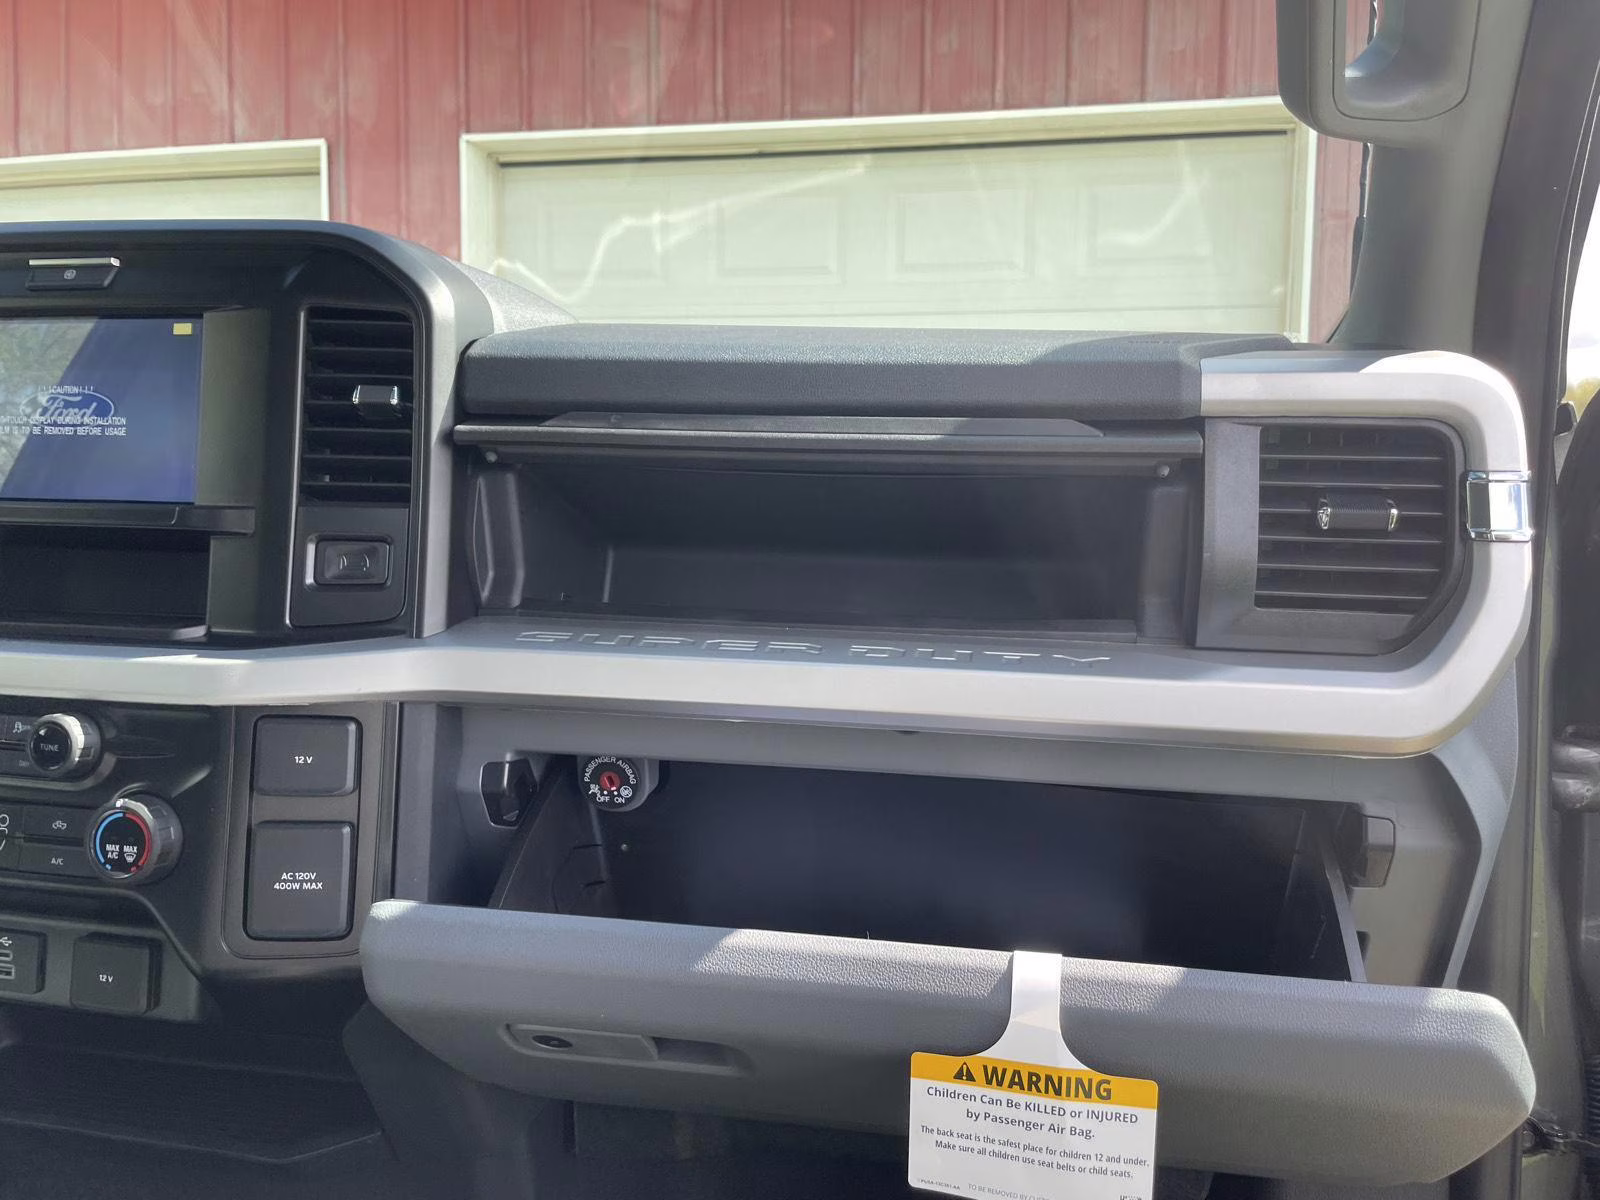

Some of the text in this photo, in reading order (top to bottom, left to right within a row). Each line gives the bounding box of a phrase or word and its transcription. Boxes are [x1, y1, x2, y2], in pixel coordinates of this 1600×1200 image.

[37, 394, 98, 420] Ford
[84, 416, 127, 426] INSTALLATION
[32, 426, 41, 435] BE
[44, 426, 74, 435] REMOVED
[77, 426, 102, 435] BEFORE
[104, 426, 127, 436] USAGE
[515, 631, 1112, 669] SUPER DUTY
[40, 743, 60, 752] TUNE
[294, 755, 313, 764] 12 V
[583, 756, 637, 785] PASSENGER AIRBAG
[596, 795, 625, 804] OFF ON
[105, 844, 138, 853] MAX MAX
[107, 851, 119, 859] A/C
[51, 857, 64, 865] A/C
[281, 872, 316, 881] AC 120V
[273, 881, 323, 890] 400W MAX
[99, 974, 114, 983] 12 V
[982, 1064, 1112, 1101] WARNING
[927, 1086, 1138, 1124] Children Can Be KILLED or INJURED
[966, 1108, 1095, 1140] by Passenger Air Bag.
[920, 1125, 1150, 1167] The back seat is the safest place for children 12 and under.
[935, 1140, 1134, 1179] Make sure all children use seat belts or child seats.
[987, 1187, 1018, 1199] REMOVED
